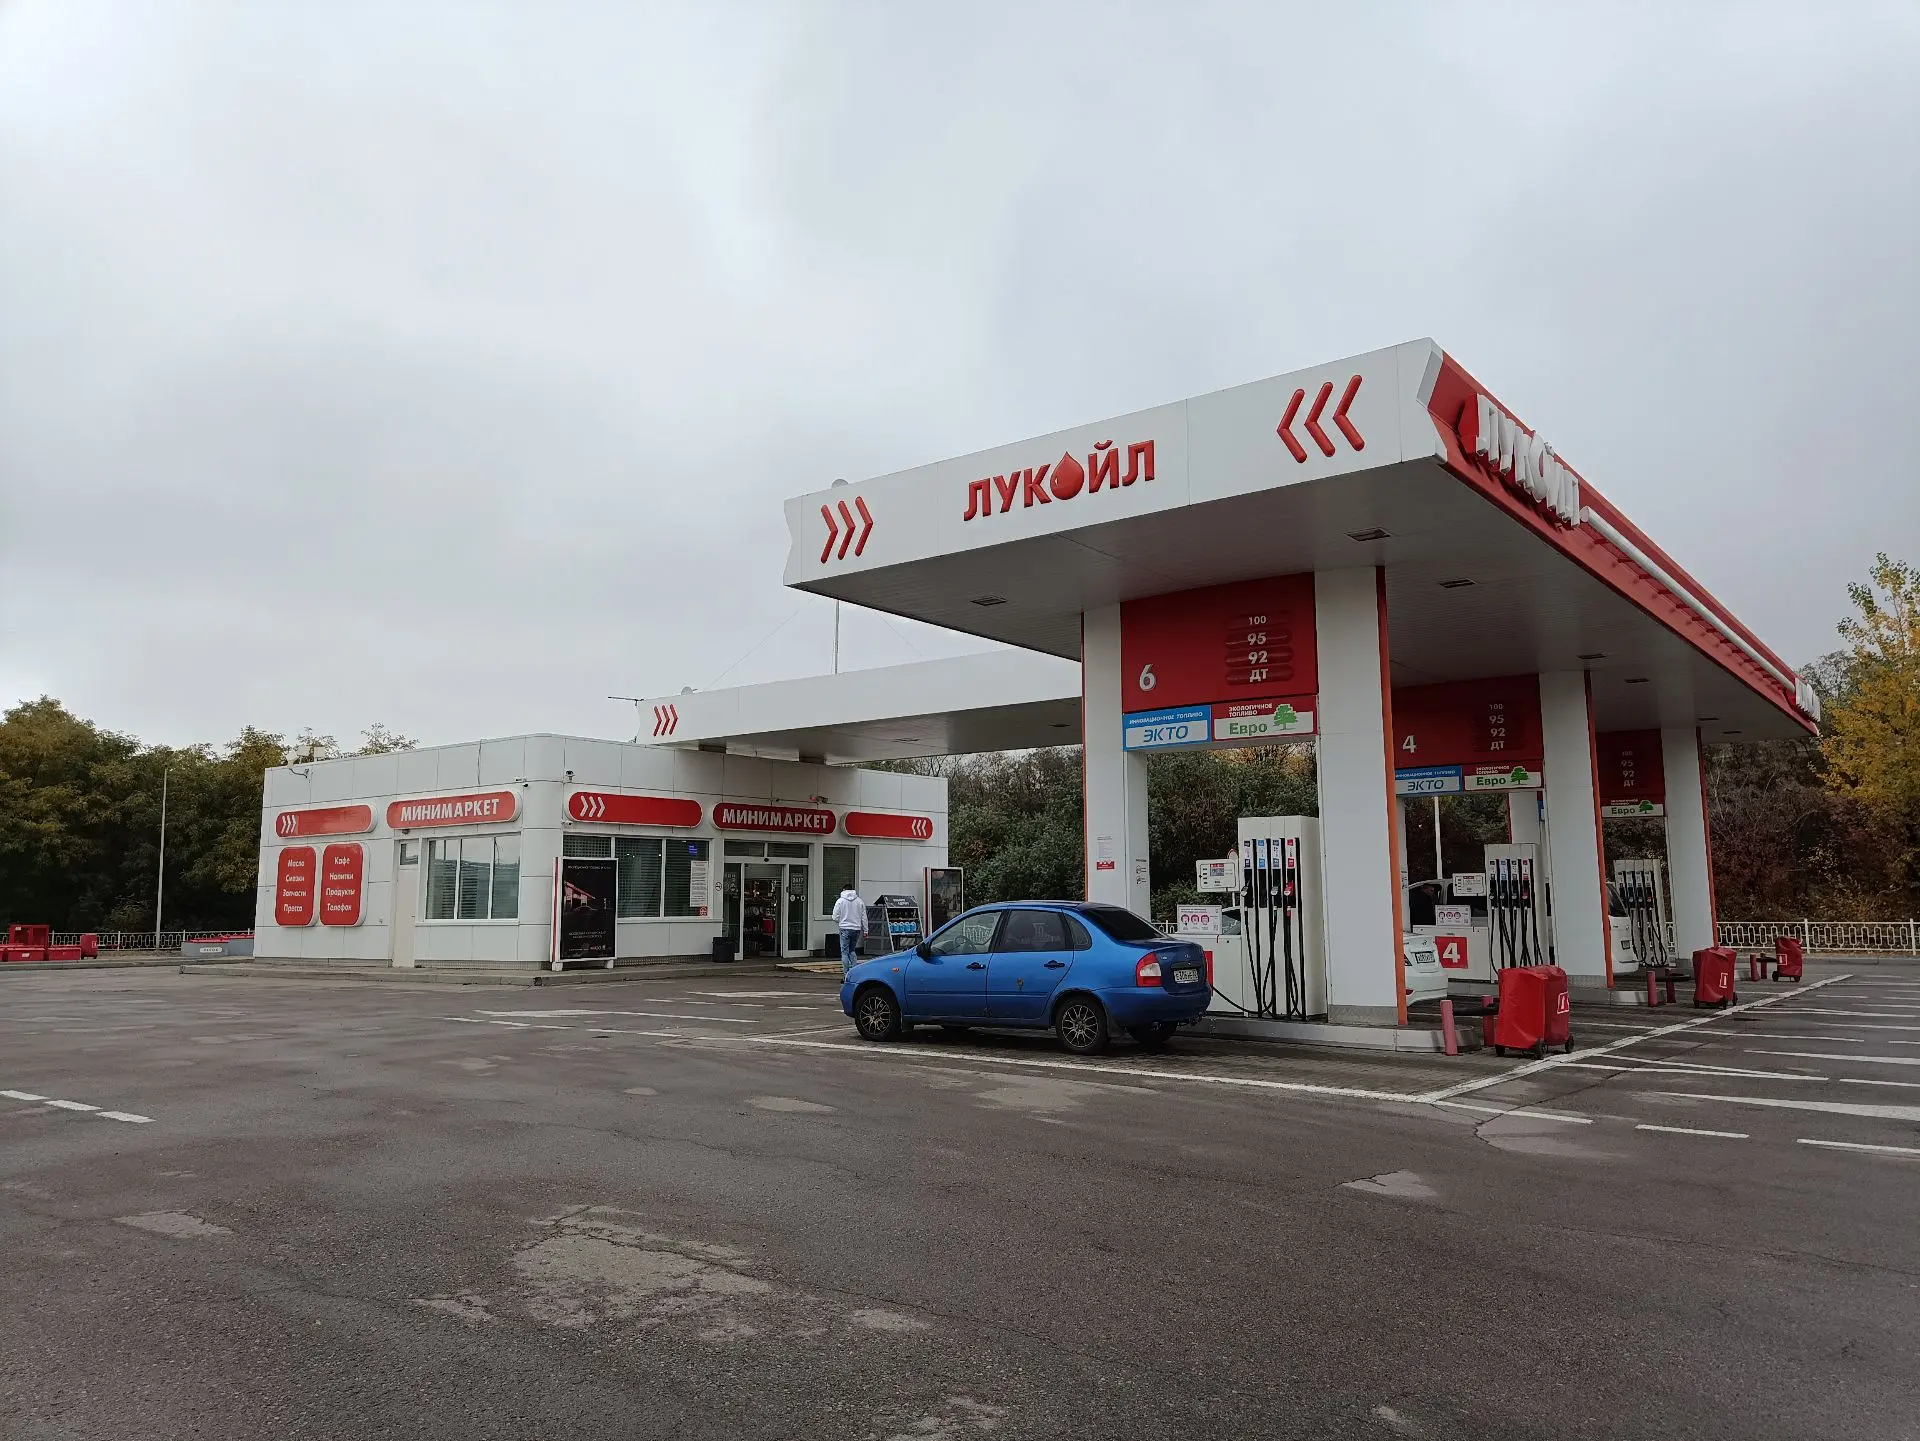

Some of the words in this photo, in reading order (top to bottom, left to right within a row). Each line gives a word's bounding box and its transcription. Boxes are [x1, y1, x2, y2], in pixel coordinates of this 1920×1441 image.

[963, 439, 1155, 522] ЛУКОЙЛ
[1248, 615, 1267, 626] 100
[1247, 632, 1267, 645] 95
[1248, 650, 1268, 664] 92
[1139, 664, 1157, 692] 6
[1249, 668, 1269, 683] ДТ
[1489, 703, 1504, 711] 100
[1489, 714, 1505, 724] 95
[1143, 725, 1189, 743] ЭКТО
[1229, 722, 1268, 736] Евро
[1490, 727, 1506, 737] 92
[1402, 735, 1417, 753] 4
[1490, 740, 1505, 751] ДТ
[1407, 779, 1444, 791] ЭКТО
[1476, 776, 1507, 787] Евро
[400, 798, 500, 822] МИНИМАРКЕТ
[1611, 807, 1636, 815] Евро
[722, 807, 829, 829] МИНИМАРКЕТ
[334, 856, 351, 867] Кафе
[329, 872, 354, 880] Напитки
[282, 888, 307, 897] Запчасти
[325, 887, 356, 898] Продукты
[283, 903, 303, 914] Пресса
[327, 903, 352, 912] Телефон
[1442, 942, 1461, 964] 4
